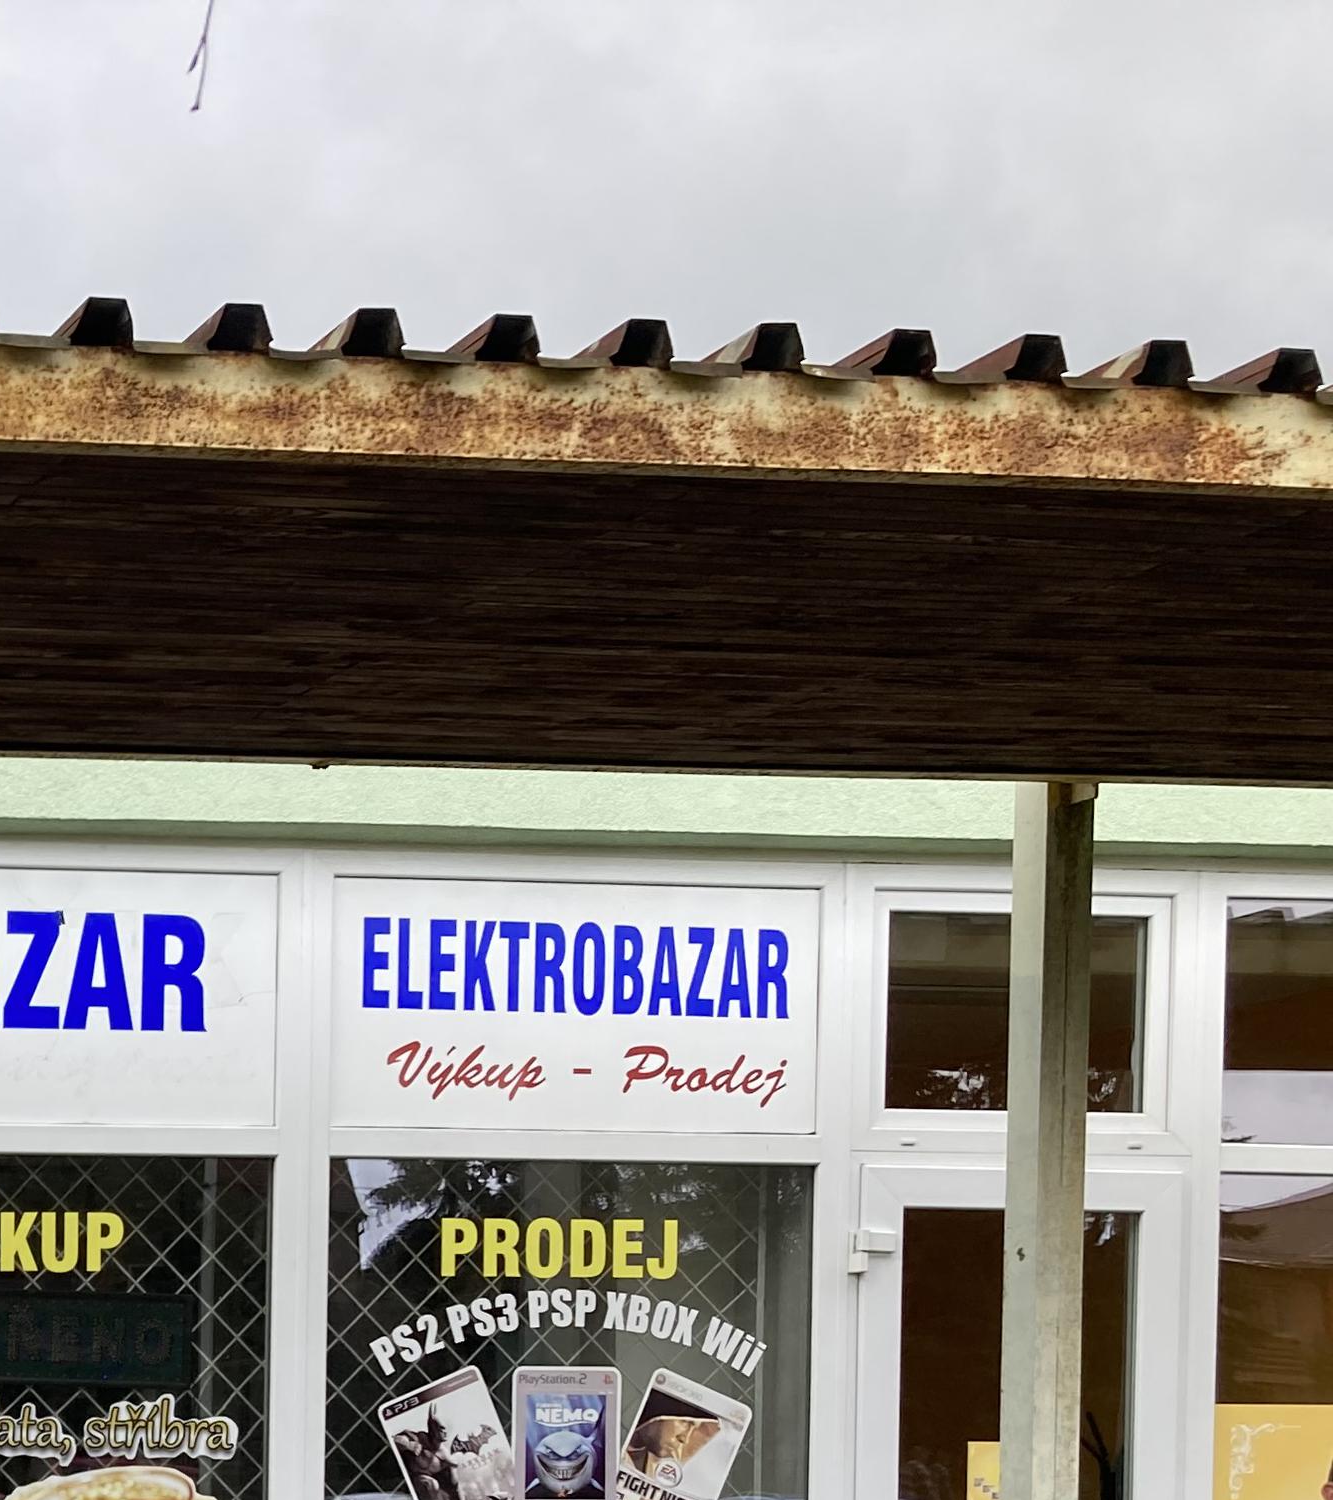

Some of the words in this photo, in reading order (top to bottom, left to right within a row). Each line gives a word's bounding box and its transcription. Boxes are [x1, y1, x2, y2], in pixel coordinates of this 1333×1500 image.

[362, 917, 790, 1019] ELEKTROBAZAR
[386, 1041, 546, 1101] Výkup
[623, 1045, 788, 1108] Prodej
[439, 1217, 679, 1279] PRODEJ
[369, 1314, 445, 1376] PS2
[445, 1293, 520, 1345] PS3
[528, 1288, 599, 1328] PSP
[603, 1292, 699, 1347] XBOX
[700, 1316, 768, 1378] Wii
[518, 1374, 576, 1386] PlayStation
[579, 1373, 588, 1385] 2
[83, 1397, 235, 1452] stříbra
[393, 1396, 420, 1414] PS3
[535, 1408, 600, 1424] NEMO
[617, 1471, 661, 1500] FIGHT
[660, 1464, 678, 1479] EA
